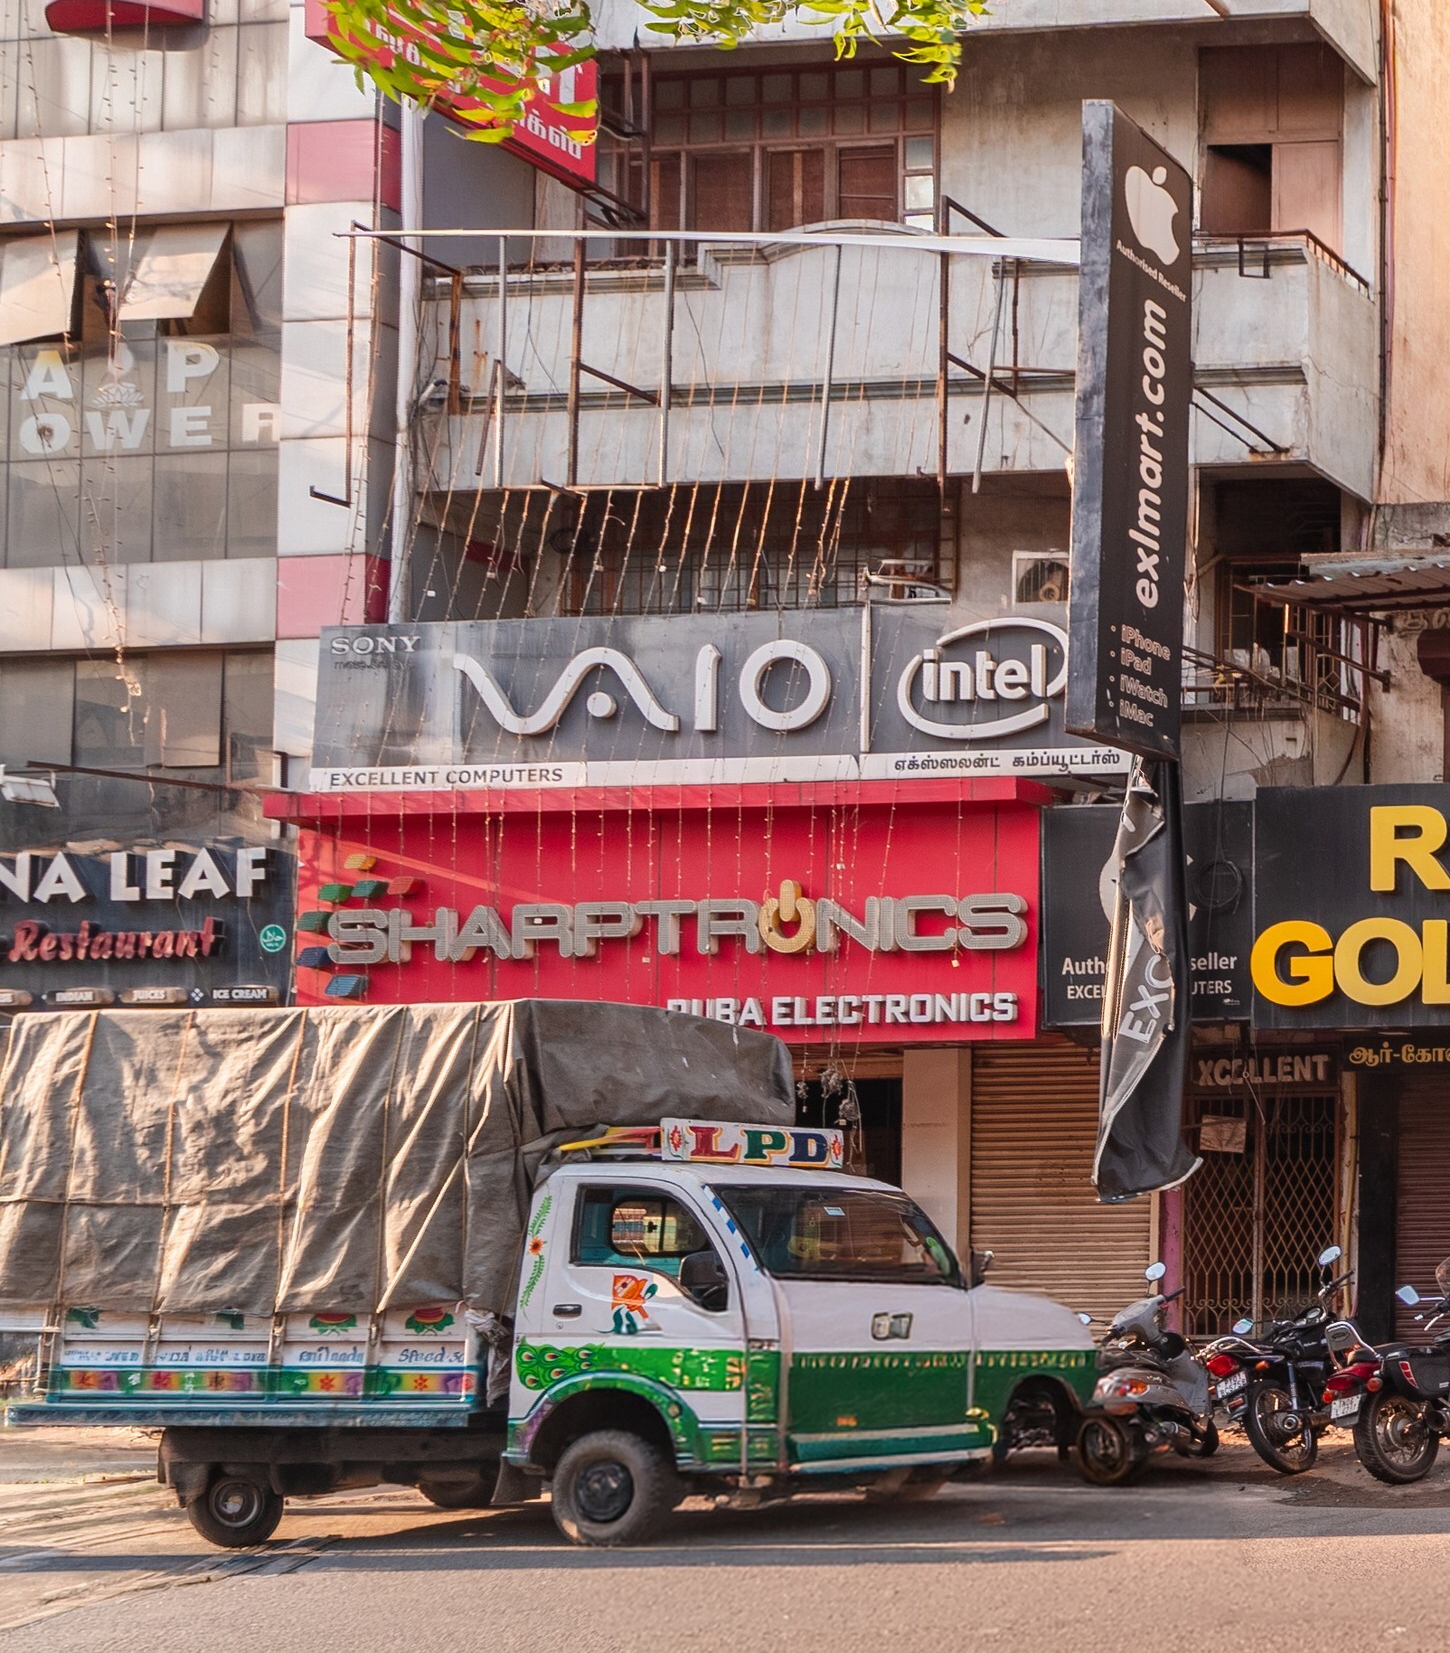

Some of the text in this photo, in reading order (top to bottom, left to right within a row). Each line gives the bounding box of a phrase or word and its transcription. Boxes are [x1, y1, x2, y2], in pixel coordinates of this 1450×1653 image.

[1116, 239, 1187, 302] Authorised Reseller
[331, 635, 421, 655] SONY
[1122, 624, 1172, 661] iPhone
[922, 644, 1048, 701] intel
[1121, 647, 1152, 676] iPad
[452, 639, 831, 736] VAIO
[1120, 675, 1168, 708] iWatch
[1119, 699, 1154, 728] iMac
[330, 768, 563, 787] EXCELLENT COMPUTERS
[110, 847, 267, 902] LEAF
[8, 915, 220, 963] Restaurant
[328, 881, 1029, 965] SHARPTRONICS
[1190, 952, 1238, 971] seller
[212, 990, 230, 1000] ICE
[231, 989, 267, 999] CREAM
[772, 992, 1017, 1026] ELECTRONICS
[1198, 1054, 1329, 1086] XCELLENT
